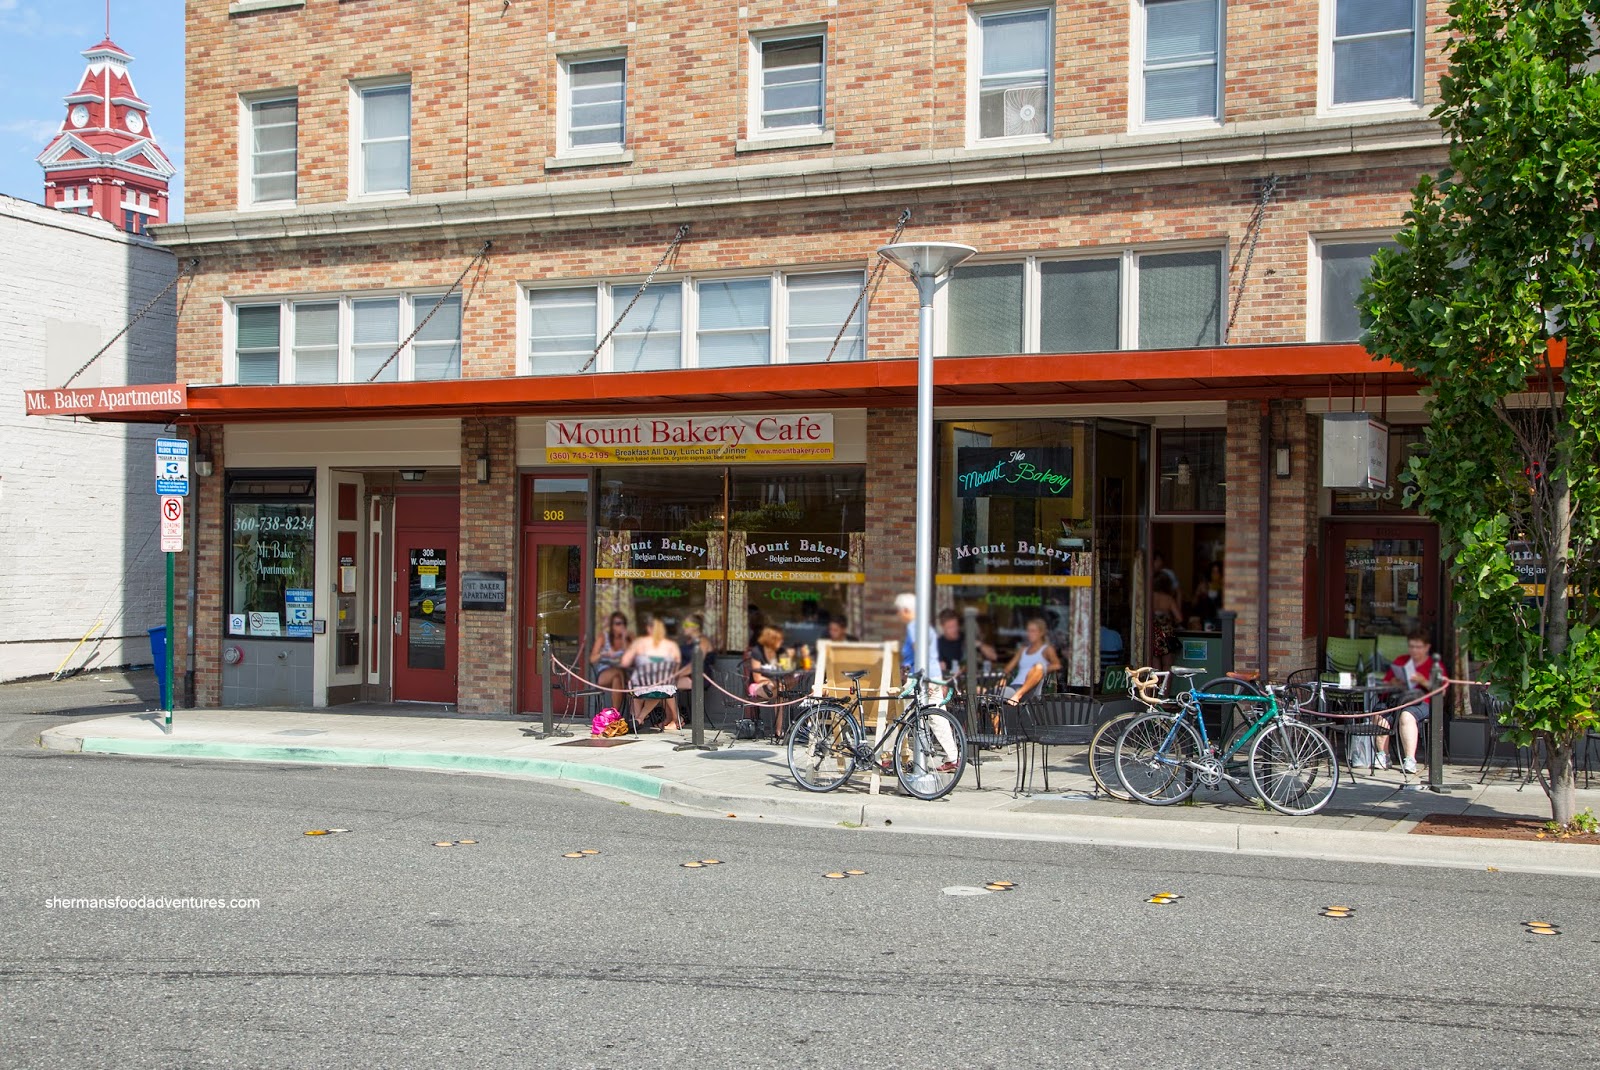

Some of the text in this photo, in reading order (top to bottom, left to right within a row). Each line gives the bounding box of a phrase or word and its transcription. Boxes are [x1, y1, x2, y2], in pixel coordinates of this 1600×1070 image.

[28, 388, 181, 410] Mt. Baker Apartments
[557, 416, 822, 448] Mount Bakery Cafe
[550, 452, 570, 460] (360)
[663, 448, 678, 456] Day,
[754, 447, 830, 456] www.mountbakery.com
[1008, 450, 1026, 463] The
[959, 460, 1072, 494] Mount Bakery
[543, 510, 564, 520] 308
[234, 516, 314, 531] 360-738-8234
[256, 540, 295, 558] Mt. Baker
[610, 538, 706, 558] Mount Bakery
[744, 539, 848, 560] Mount Bakery
[956, 541, 1071, 563] Mount Bakery
[419, 558, 446, 567] Champion
[635, 553, 682, 562] Belgian Desserts
[769, 555, 821, 564] Belgian Desserts
[1014, 558, 1044, 567] Desserts
[1349, 557, 1418, 568] Mount Bakery
[252, 558, 295, 580] Apartments
[614, 570, 646, 578] ESPRESSO
[1514, 565, 1546, 576] Belgan
